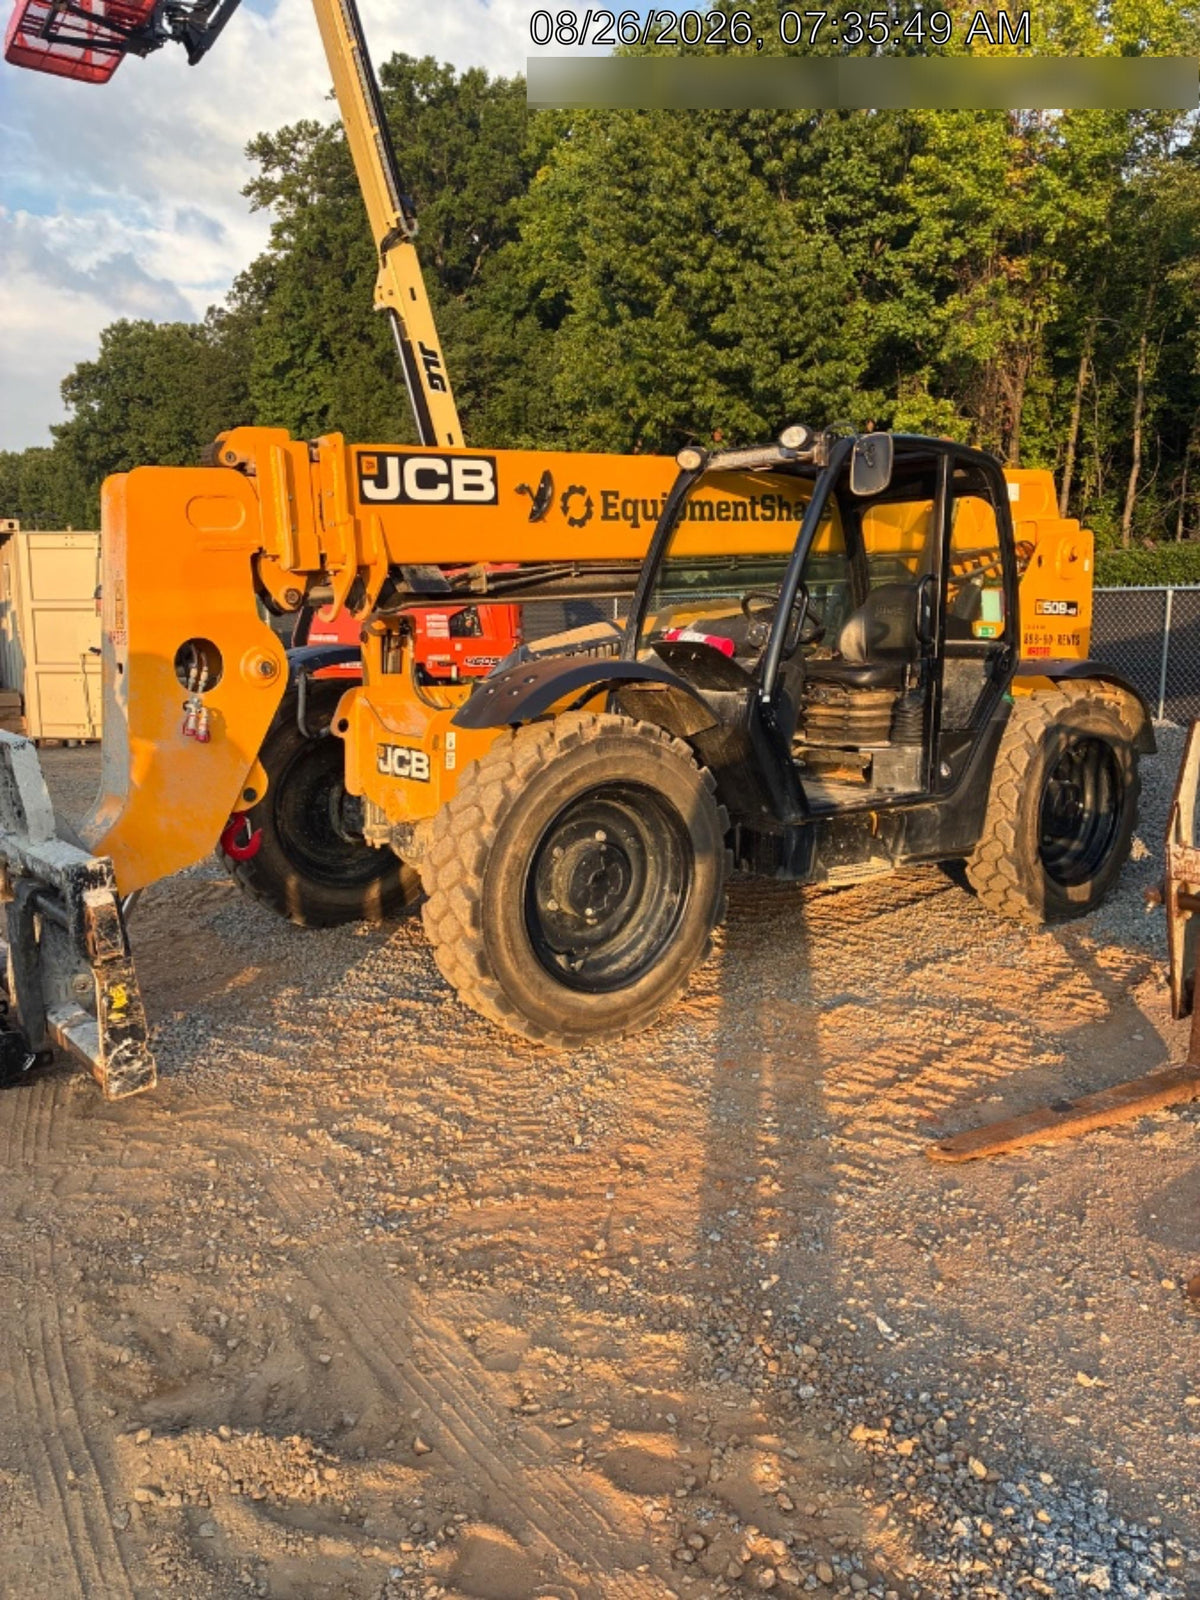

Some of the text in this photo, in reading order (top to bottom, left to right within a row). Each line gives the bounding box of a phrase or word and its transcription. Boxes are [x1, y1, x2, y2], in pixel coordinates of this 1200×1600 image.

[418, 341, 447, 393] JLG
[362, 456, 497, 502] JCB
[378, 746, 430, 780] JCB
